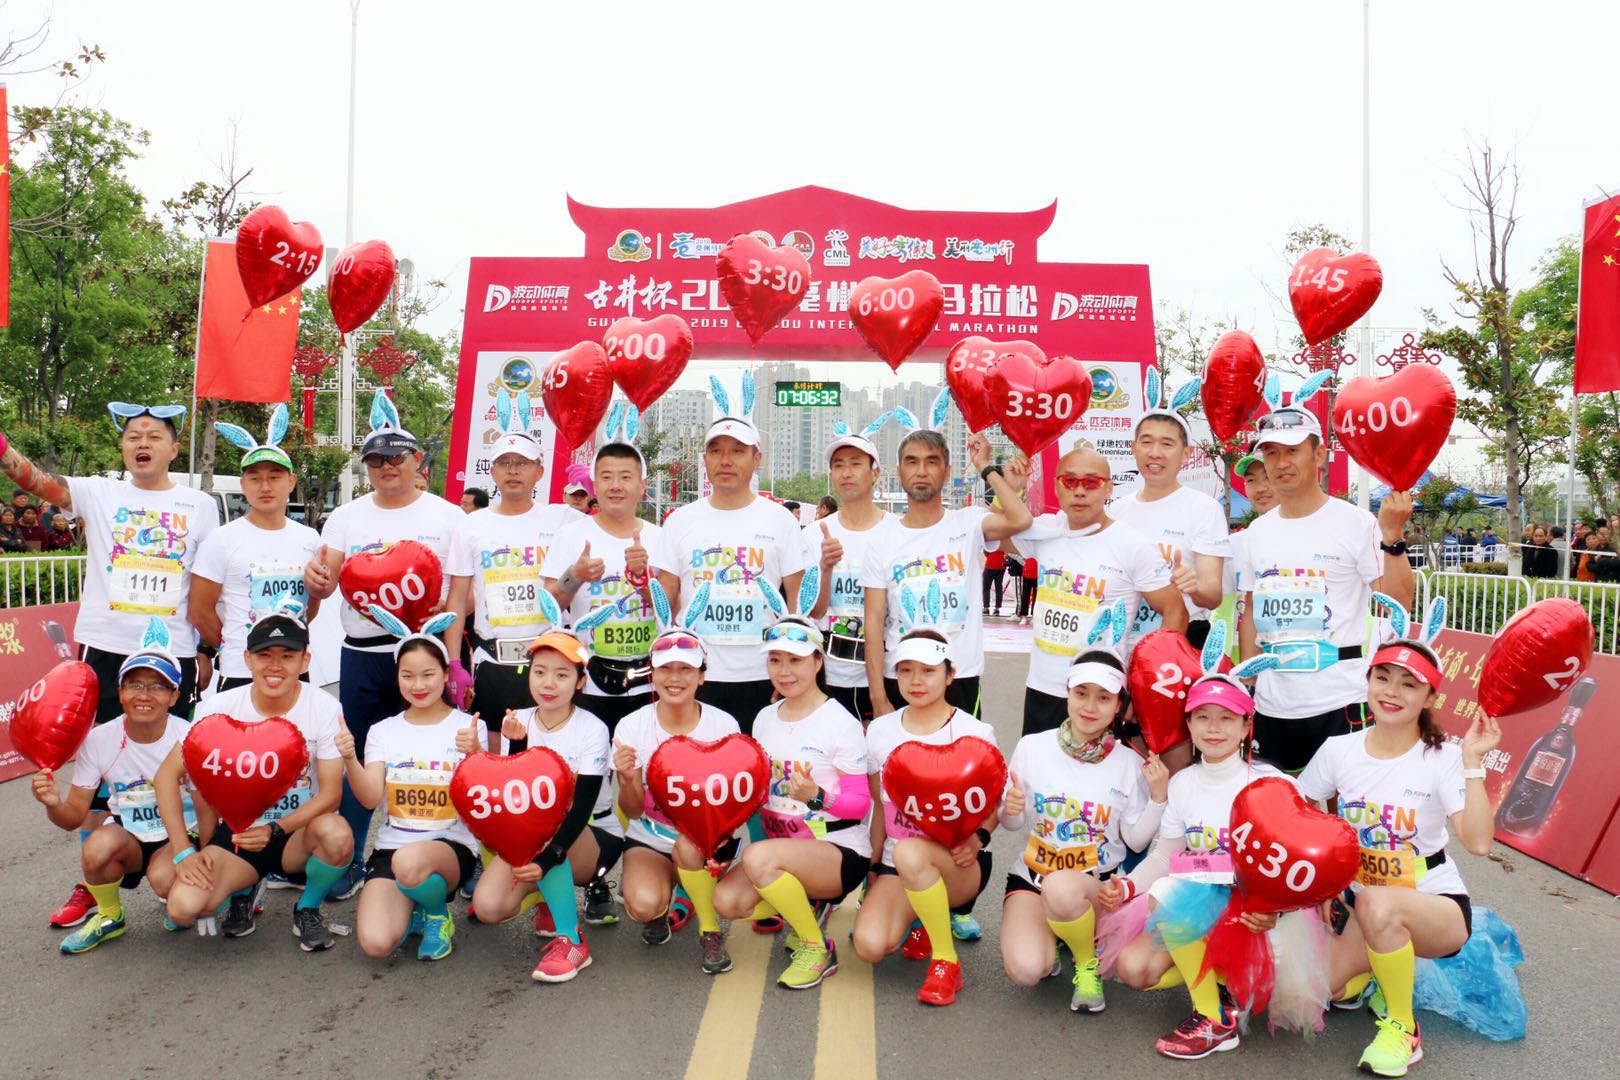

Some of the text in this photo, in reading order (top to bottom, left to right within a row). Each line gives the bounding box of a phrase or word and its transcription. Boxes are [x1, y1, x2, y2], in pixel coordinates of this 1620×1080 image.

[270, 242, 317, 276] 2:15
[825, 250, 849, 259] CML
[744, 259, 802, 295] 3:30
[1293, 264, 1348, 293] 1:45
[512, 286, 571, 299] 波动体育
[858, 287, 915, 317] 6:00
[1079, 294, 1139, 309] 波动体育
[691, 319, 728, 327] 2019
[949, 323, 1038, 334] MARATHON
[605, 333, 666, 362] 2:00
[953, 349, 999, 372] 3:3
[778, 390, 838, 405] 07:06:32
[1005, 389, 1073, 420] 3:30
[1089, 416, 1131, 428] 匹克体育
[1340, 396, 1413, 438] 4:00
[131, 574, 168, 593] 1111
[262, 580, 304, 597] A0936
[352, 573, 426, 617] 3:00
[507, 584, 535, 602] 928
[704, 604, 753, 622] A0918
[1262, 598, 1314, 618] A0935
[1044, 609, 1079, 632] 6666
[604, 626, 651, 644] B3208
[202, 748, 279, 778] 4:00
[396, 789, 448, 807] B6940
[467, 775, 556, 820] 3:00
[667, 771, 754, 807] 5:00
[904, 786, 987, 823] 4:30
[1036, 846, 1087, 871] B7004
[1231, 821, 1316, 893] 4:30
[1359, 852, 1402, 877] 6503
